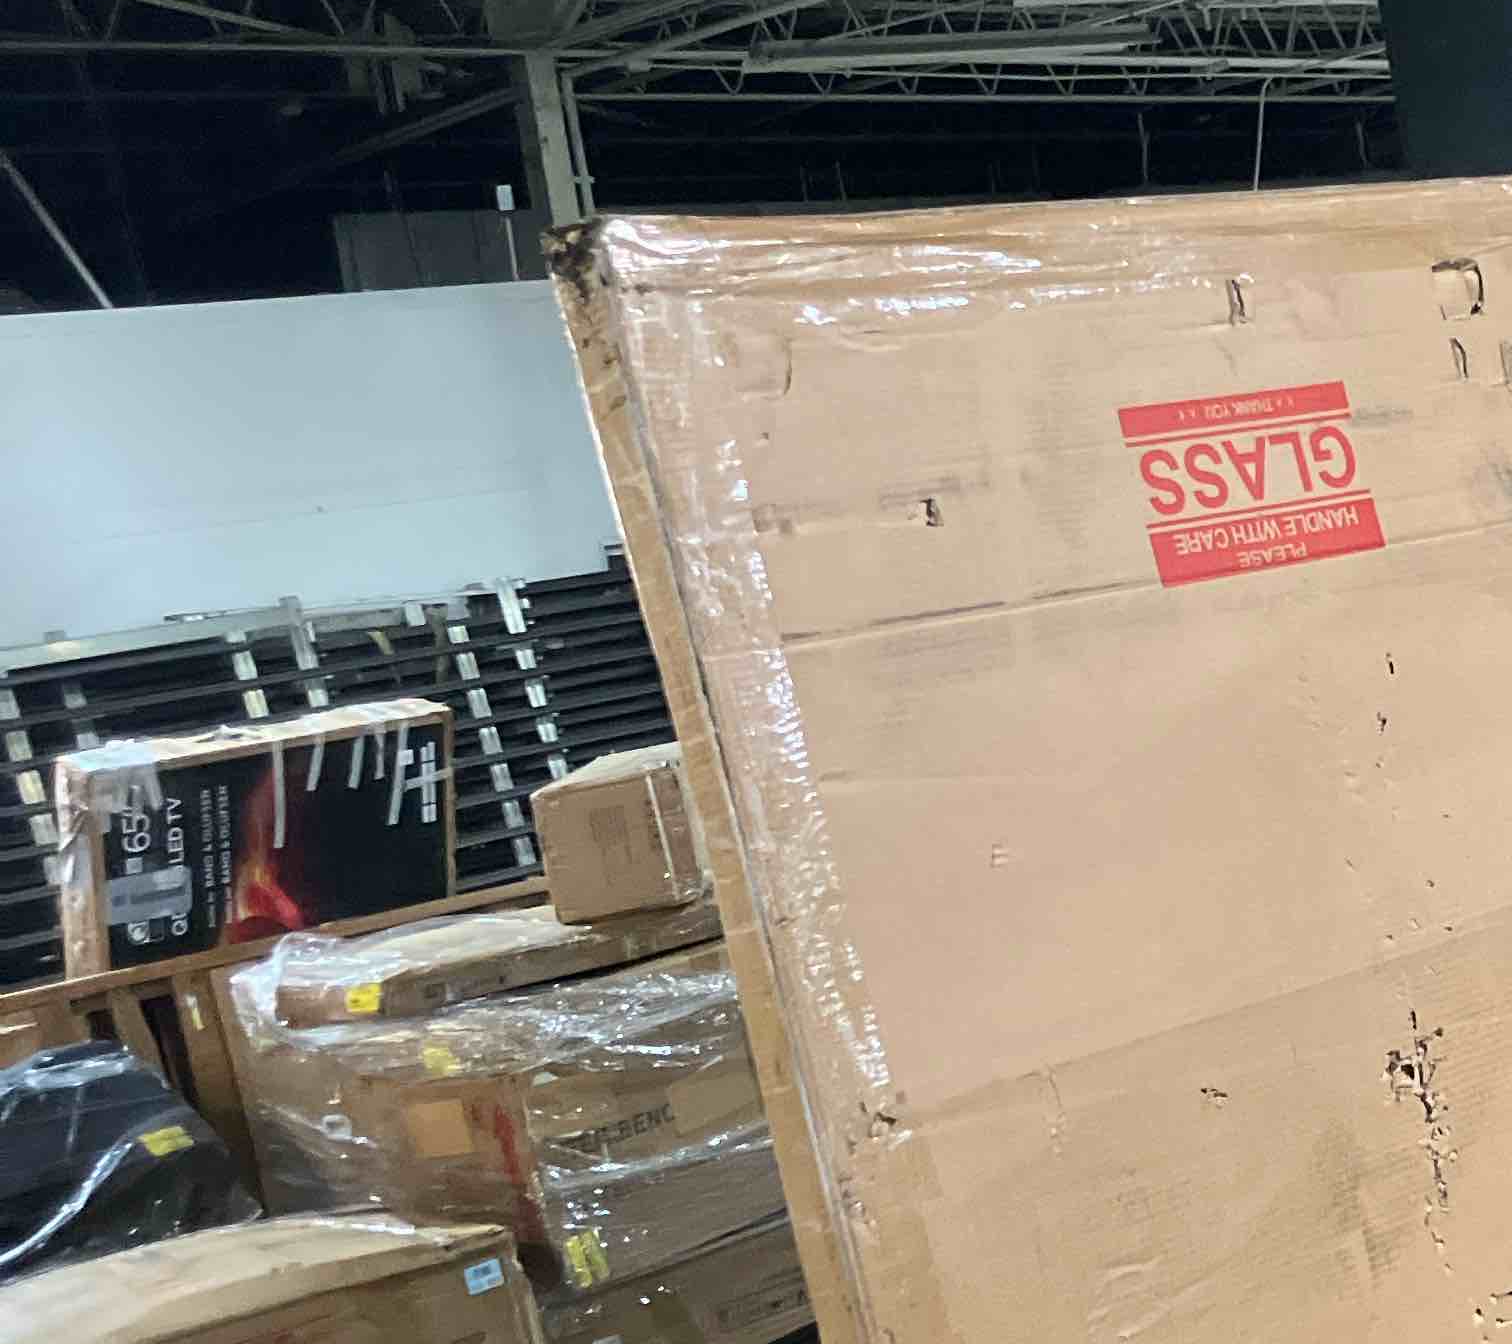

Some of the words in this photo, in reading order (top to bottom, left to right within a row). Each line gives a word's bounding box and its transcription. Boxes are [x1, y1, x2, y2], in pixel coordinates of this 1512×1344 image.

[1139, 425, 1356, 516] GLASS
[1233, 519, 1281, 545] WITH
[1283, 506, 1360, 536] HANDLE
[1173, 527, 1230, 555] CARE
[1238, 542, 1308, 568] PLEASE
[165, 797, 184, 825] TV
